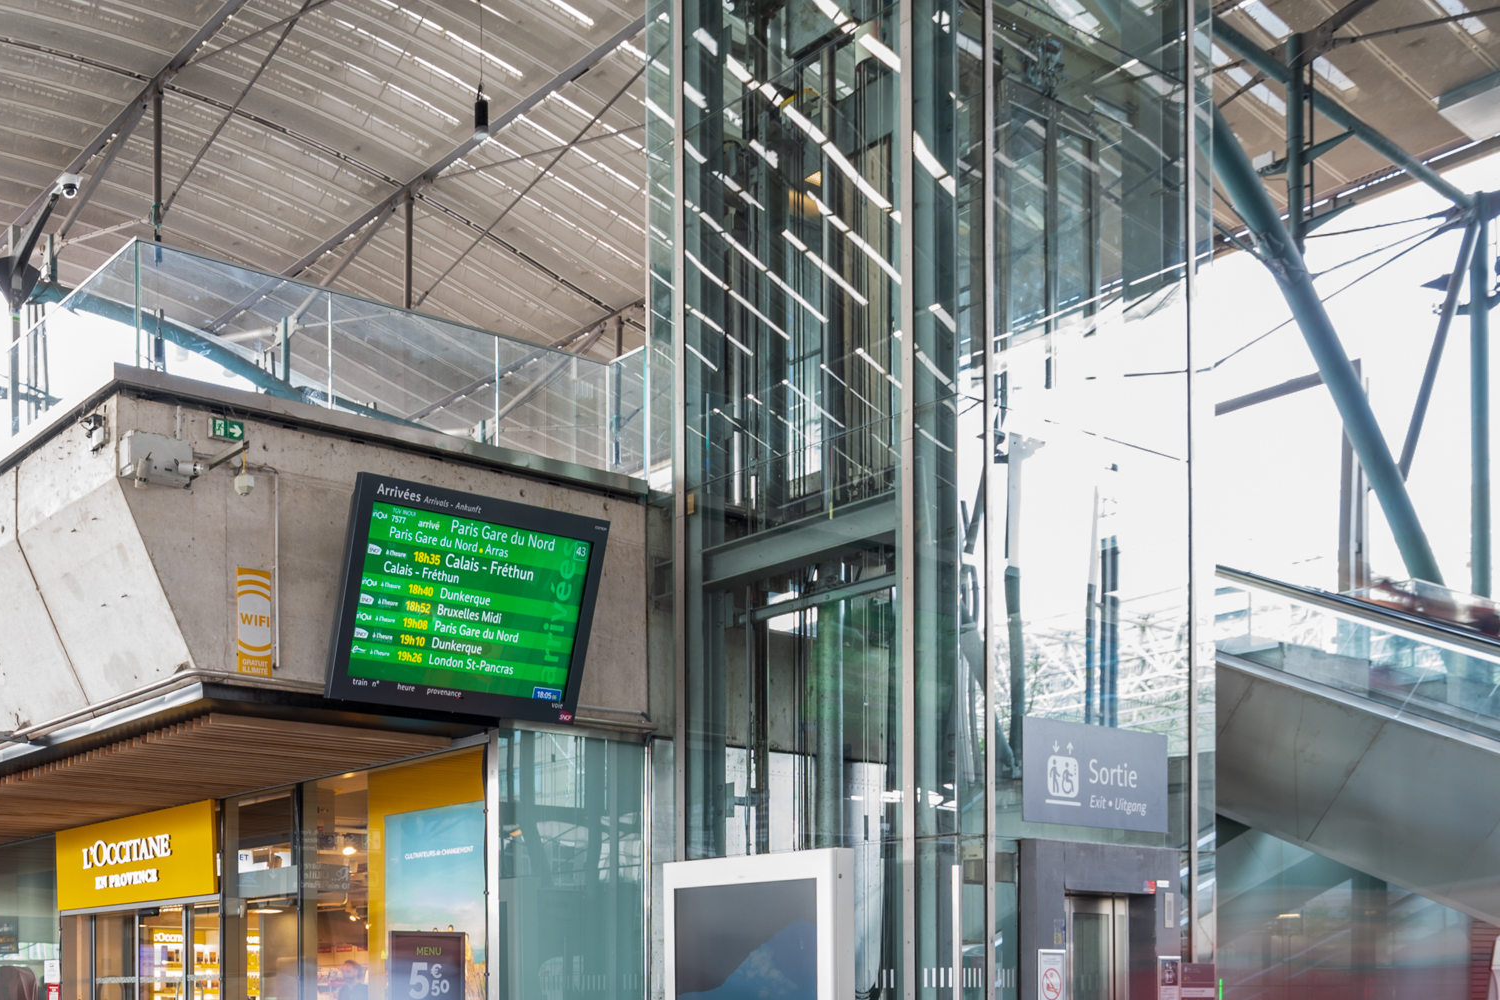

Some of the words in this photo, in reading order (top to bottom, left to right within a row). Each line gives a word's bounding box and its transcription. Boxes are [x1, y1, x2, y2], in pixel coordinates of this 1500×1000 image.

[377, 483, 421, 502] Arrivées
[423, 496, 449, 508] Arrivals
[455, 501, 482, 514] Ankunft
[391, 514, 406, 524] 7577
[418, 519, 440, 531] arrivé
[389, 526, 412, 541] Paris
[415, 531, 438, 546] Gare
[440, 536, 452, 548] du
[454, 538, 479, 553] Nord
[484, 544, 509, 558] Arras
[450, 519, 479, 537] Paris
[481, 525, 508, 543] Gare
[510, 531, 525, 546] du
[527, 533, 556, 551] Nord
[413, 550, 441, 566] 18h35
[575, 546, 587, 557] 43
[383, 560, 413, 576] Calais
[422, 567, 460, 584] Fréthun
[445, 553, 480, 572] Calais
[490, 560, 534, 581] Fréthun
[408, 583, 434, 597] 18h40
[440, 587, 491, 607] Dunkerque
[405, 600, 432, 614] 18h52
[437, 603, 480, 621] Bruxelles
[481, 610, 502, 624] Midi
[240, 612, 270, 628] WIFI
[402, 617, 429, 631] 19h08
[434, 620, 457, 634] Paris
[459, 624, 481, 638] Gare
[482, 627, 494, 640] du
[496, 629, 519, 643] Nord
[400, 634, 426, 647] 19h10
[431, 636, 482, 656] Dunkerque
[242, 658, 268, 667] GRATUIT
[397, 651, 423, 664] 19h26
[428, 653, 463, 668] London
[466, 658, 514, 675] St-Pancras
[242, 666, 268, 675] ILLIMITÉ
[352, 678, 368, 687] train
[397, 683, 415, 692] heure
[426, 687, 462, 698] provenance
[551, 701, 564, 710] voie
[1089, 758, 1138, 788] Sortie
[1090, 794, 1106, 809] Exit
[1114, 797, 1147, 816] Uitgang
[82, 833, 172, 870] L'OCCITANE
[404, 850, 435, 860] CULTIVATEURS
[441, 845, 474, 856] CHANGEMENT
[95, 875, 108, 890] EN
[108, 868, 159, 888] PROVENCE
[416, 946, 442, 956] MENU
